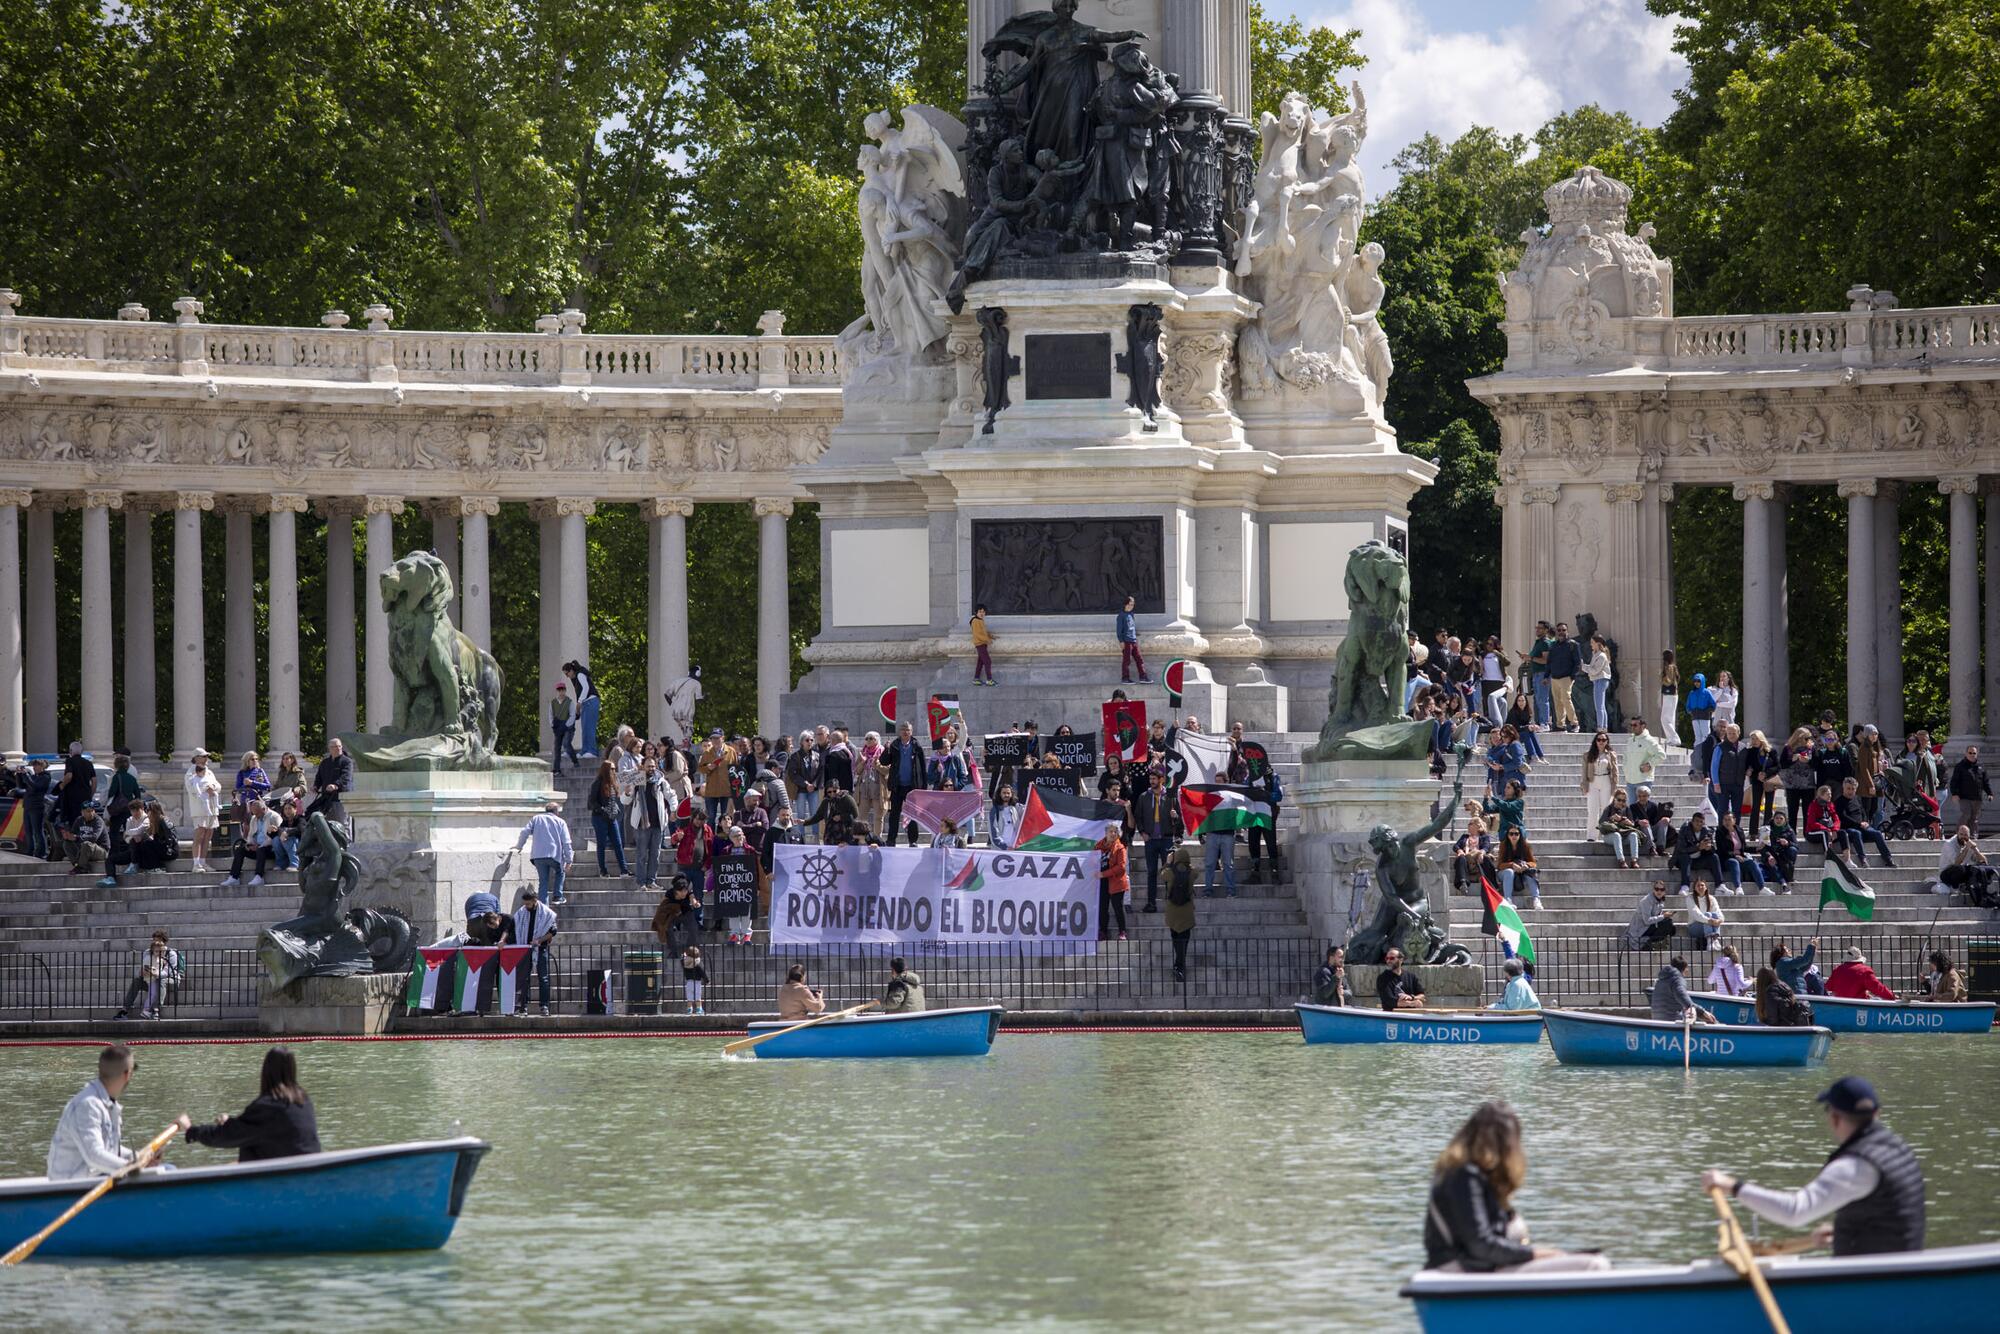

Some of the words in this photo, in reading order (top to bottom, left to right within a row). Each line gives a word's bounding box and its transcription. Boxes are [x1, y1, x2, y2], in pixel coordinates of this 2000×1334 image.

[1054, 742, 1084, 755] STOP
[1057, 753, 1092, 765] NOCIDIO
[1035, 776, 1056, 786] ALTO
[1057, 777, 1067, 787] EL
[721, 864, 734, 872] FIN
[736, 863, 748, 872] AL
[991, 854, 1085, 879] GAZA
[718, 872, 754, 885] COMERCIO
[719, 888, 753, 903] ARMAS
[787, 893, 933, 933] ROMPIENDO
[940, 898, 964, 933] EL
[971, 899, 1088, 937] BLOQUEO
[1878, 1012, 1943, 1027] MADRID
[1409, 1026, 1481, 1042] MADRID
[1651, 1034, 1735, 1055] MADRID
